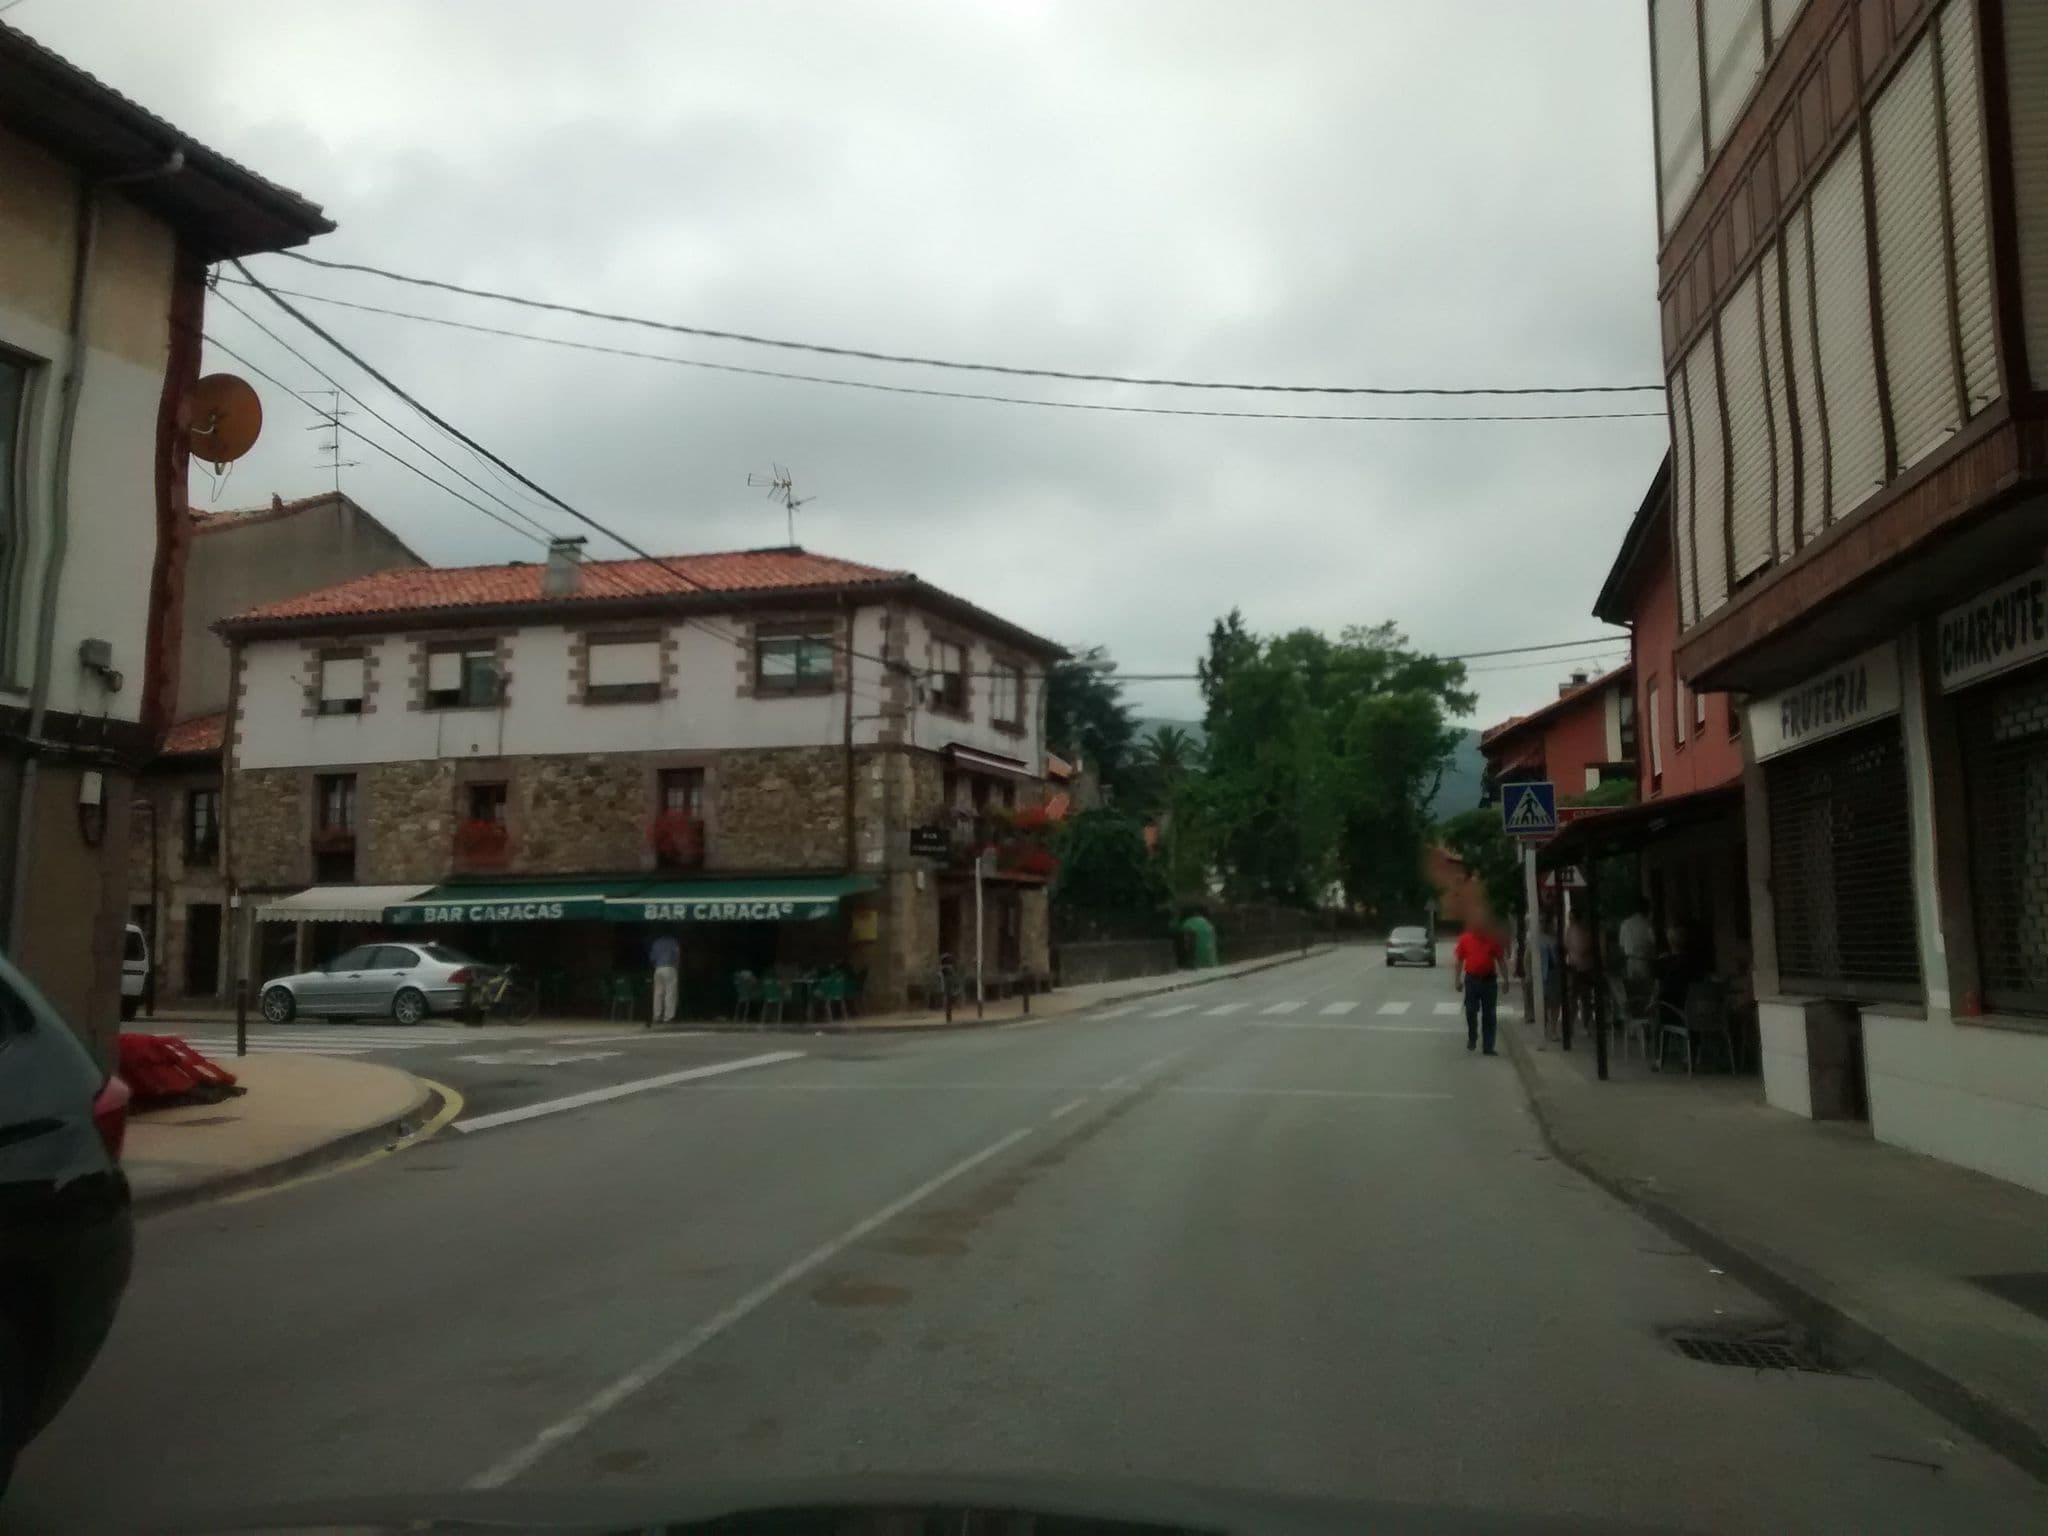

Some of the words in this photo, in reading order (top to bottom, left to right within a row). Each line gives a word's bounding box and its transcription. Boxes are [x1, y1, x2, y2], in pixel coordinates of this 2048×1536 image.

[1782, 664, 1867, 740] FRUTERIA
[424, 907, 462, 923] BAR
[469, 904, 563, 922] CARACAS
[644, 903, 686, 920] BAR
